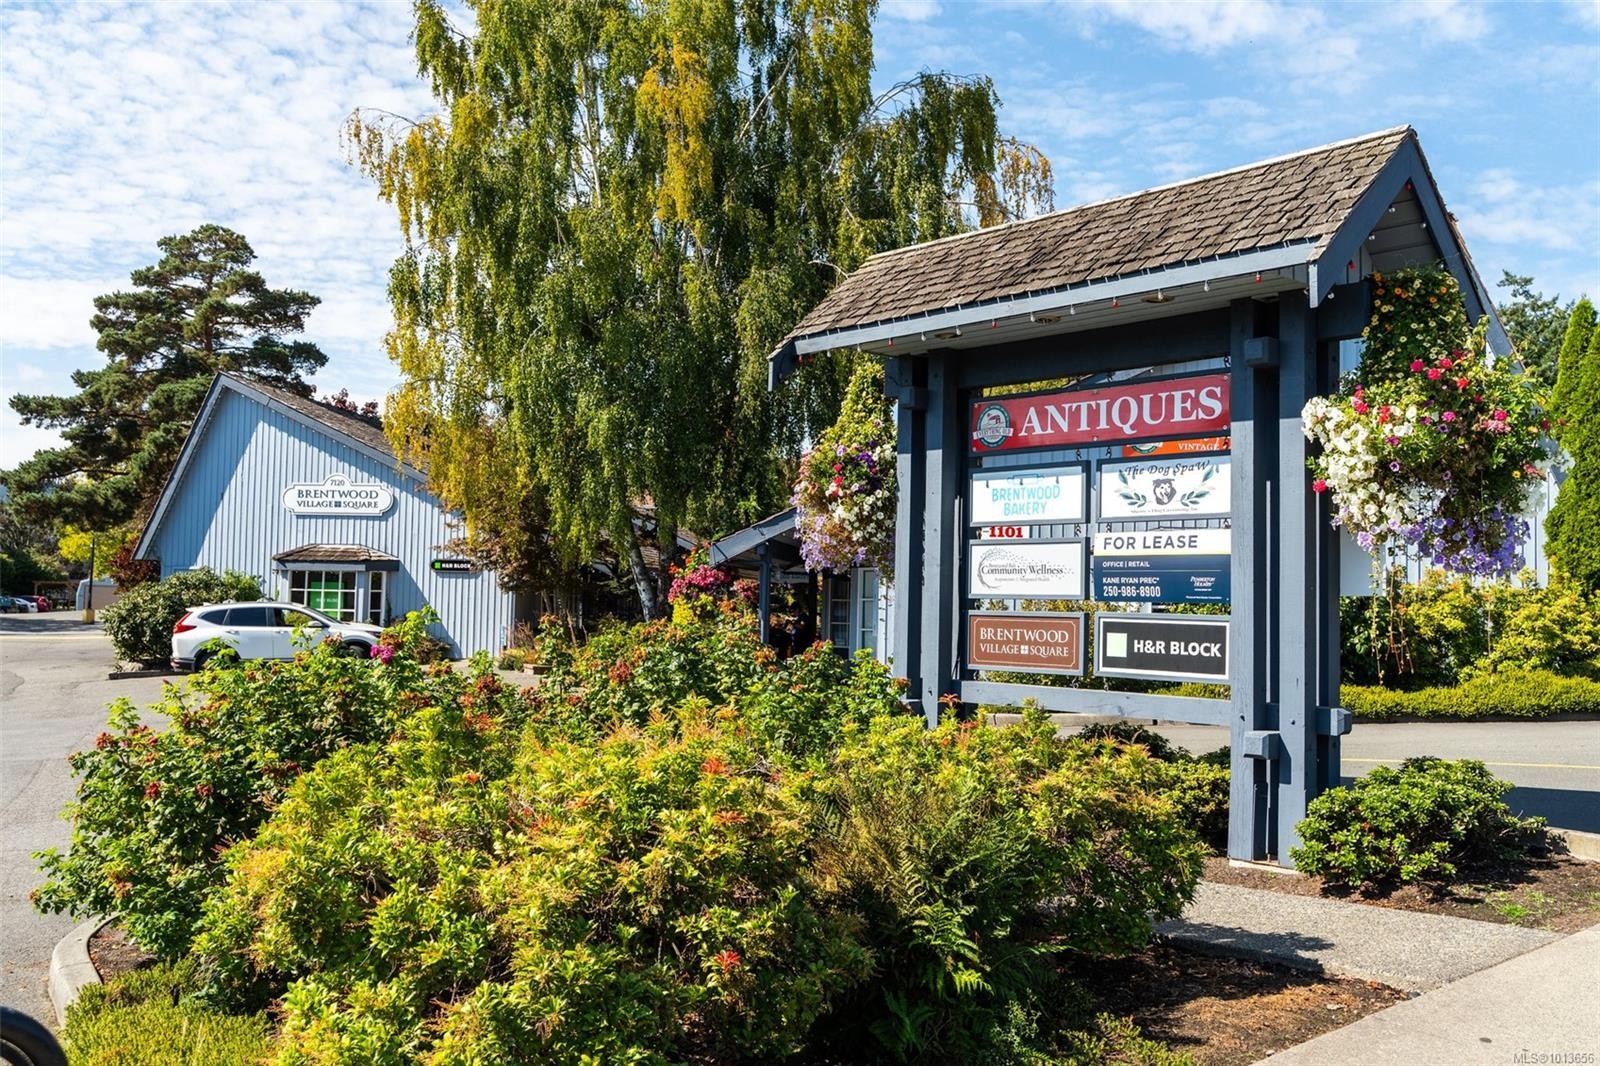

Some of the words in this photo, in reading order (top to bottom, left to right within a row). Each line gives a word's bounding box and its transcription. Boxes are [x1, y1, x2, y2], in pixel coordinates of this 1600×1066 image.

[1018, 386, 1223, 437] ANTIQUES
[1125, 465, 1145, 479] The
[1147, 464, 1170, 476] Dog
[297, 489, 379, 499] BRENTWOOD
[992, 484, 1061, 503] BRENTWOOD
[296, 500, 334, 508] VILLAGE
[342, 500, 379, 510] SQUARE
[1003, 501, 1047, 517] BAKERY
[1103, 537, 1136, 551] FOR
[1143, 534, 1199, 549] LEASE
[981, 565, 1027, 577] Community
[1028, 564, 1064, 575] Wellness
[1128, 560, 1150, 568] RETAIL
[1103, 586, 1161, 597] 250-986-8900
[979, 627, 1069, 644] BRENTWOOD
[979, 643, 1020, 655] VILLAGE
[1029, 645, 1069, 658] SQUARE
[1133, 639, 1166, 655] H&R
[1170, 641, 1222, 658] BLOCK
